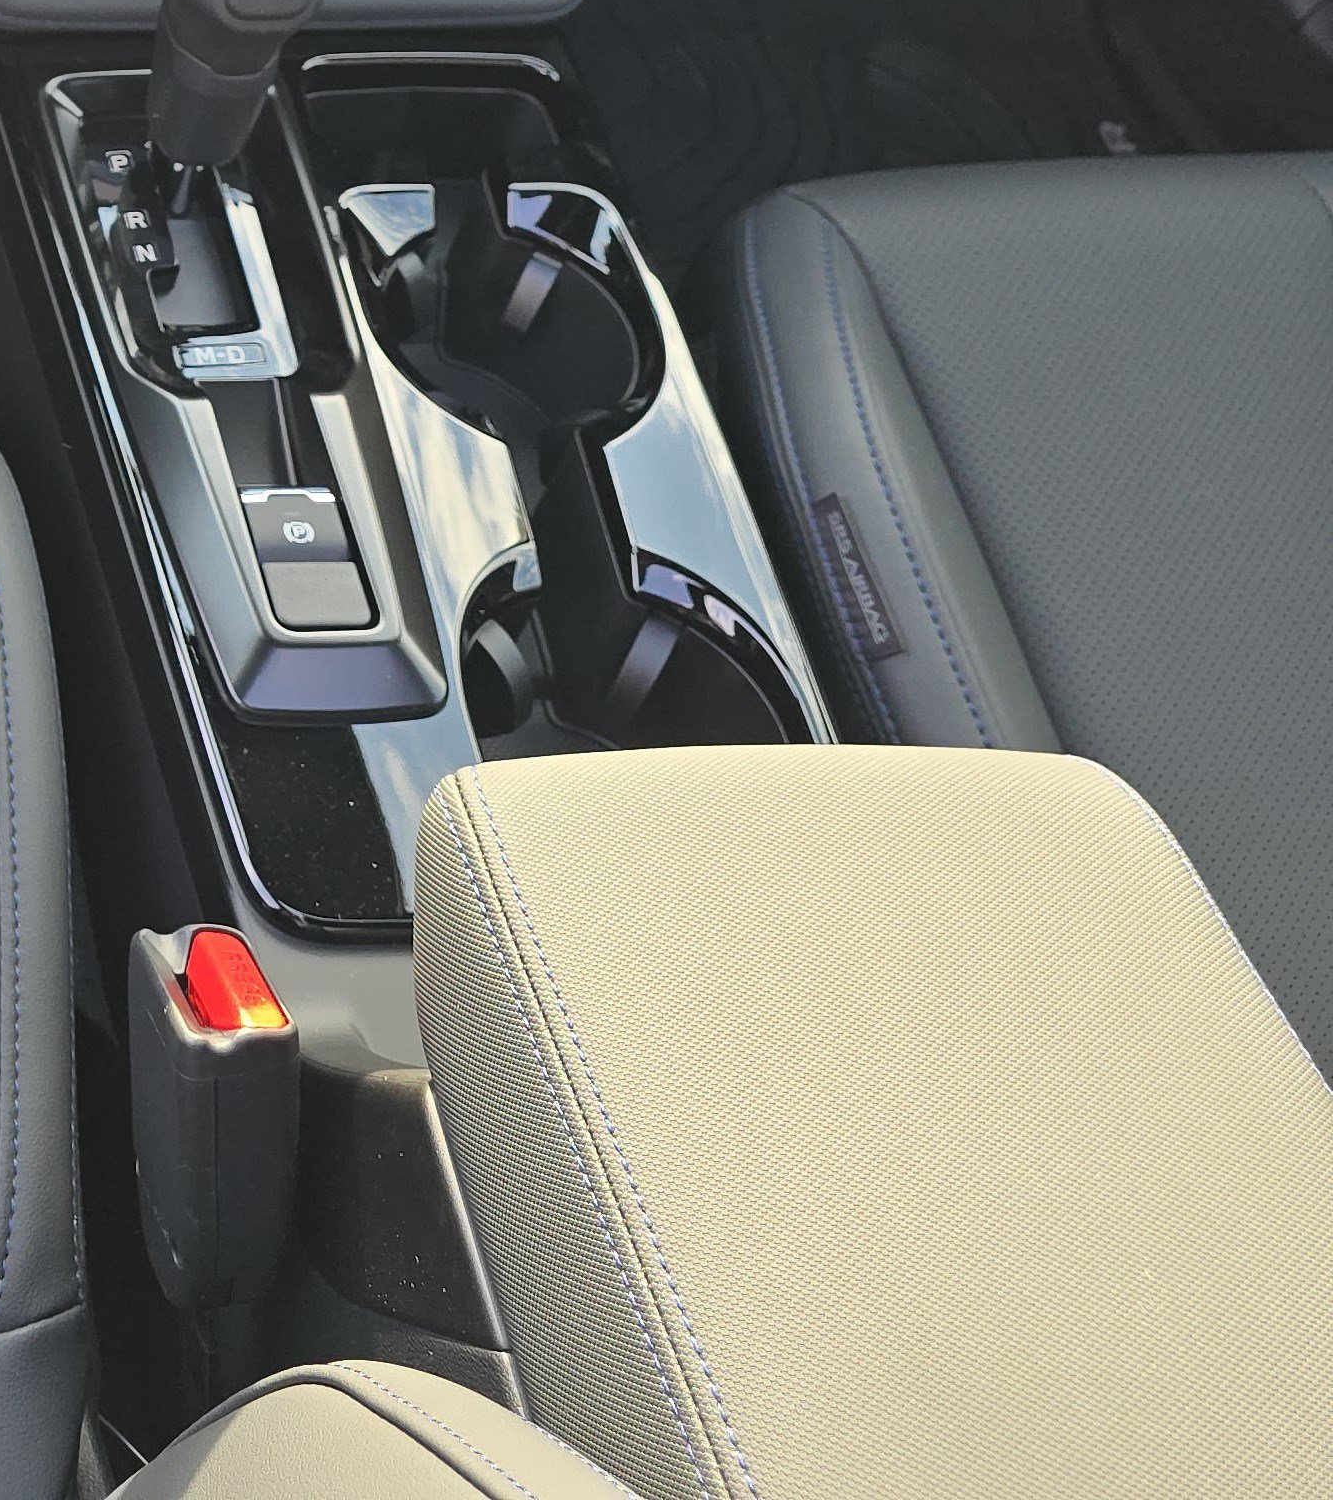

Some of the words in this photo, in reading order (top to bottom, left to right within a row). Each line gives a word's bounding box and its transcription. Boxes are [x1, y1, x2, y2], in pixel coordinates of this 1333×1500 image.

[109, 154, 129, 174] P
[123, 211, 149, 230] R
[132, 243, 159, 263] N
